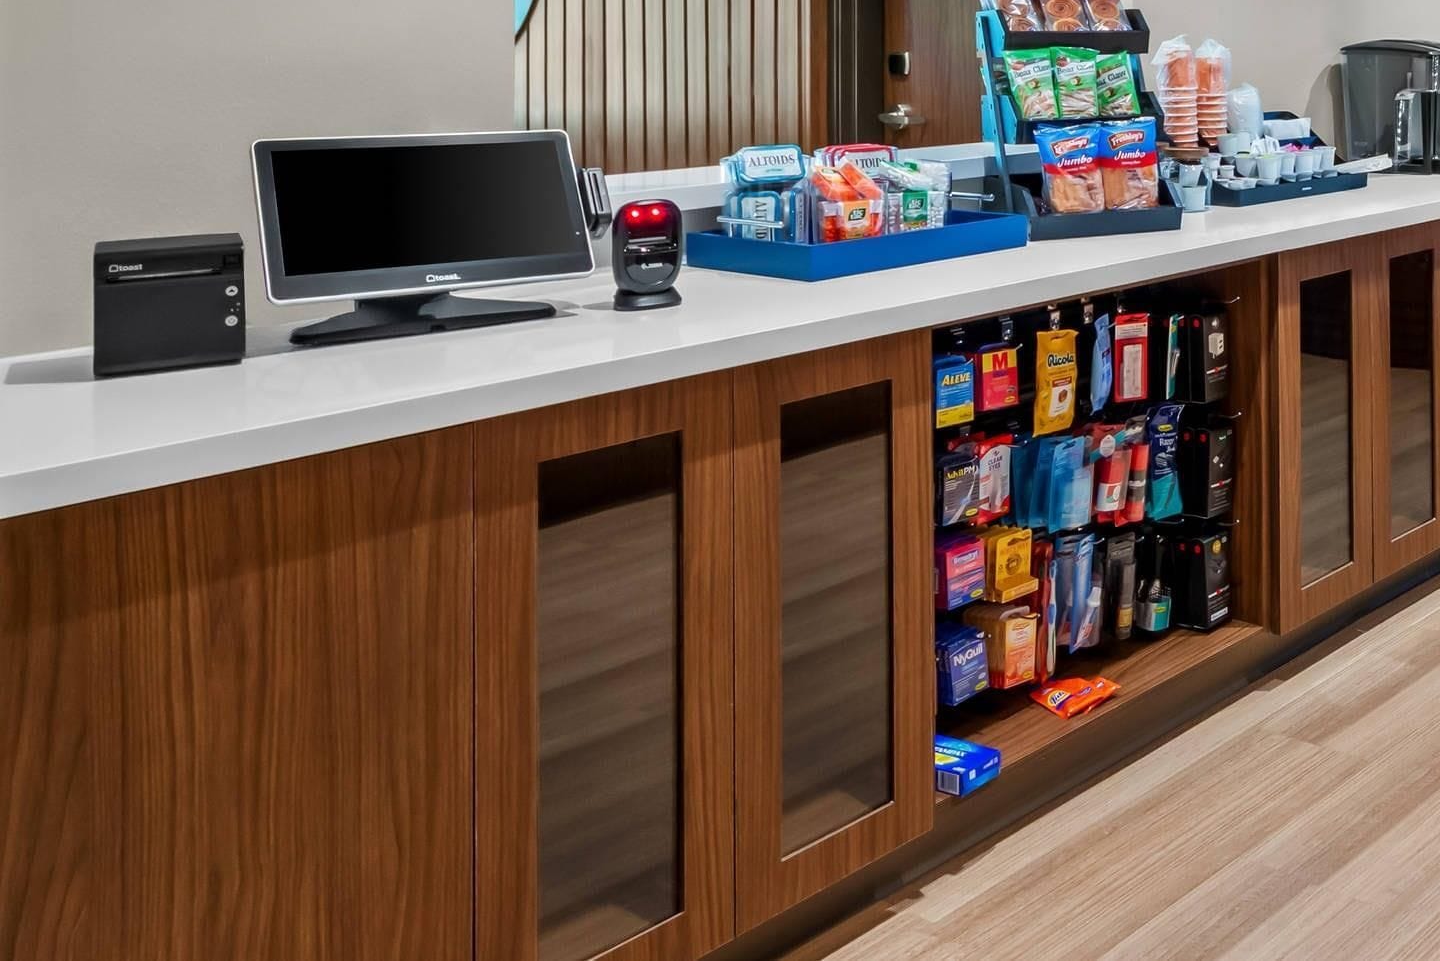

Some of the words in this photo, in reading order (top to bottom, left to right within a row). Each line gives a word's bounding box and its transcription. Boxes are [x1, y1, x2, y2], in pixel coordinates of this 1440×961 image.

[1107, 70, 1126, 83] Claw
[749, 154, 795, 167] ALTOIDS
[1057, 155, 1093, 167] Jumbo
[1114, 149, 1146, 161] Jumbo
[1047, 352, 1075, 367] Ricola
[942, 372, 971, 386] ALEVE
[953, 642, 984, 667] NyQuil
